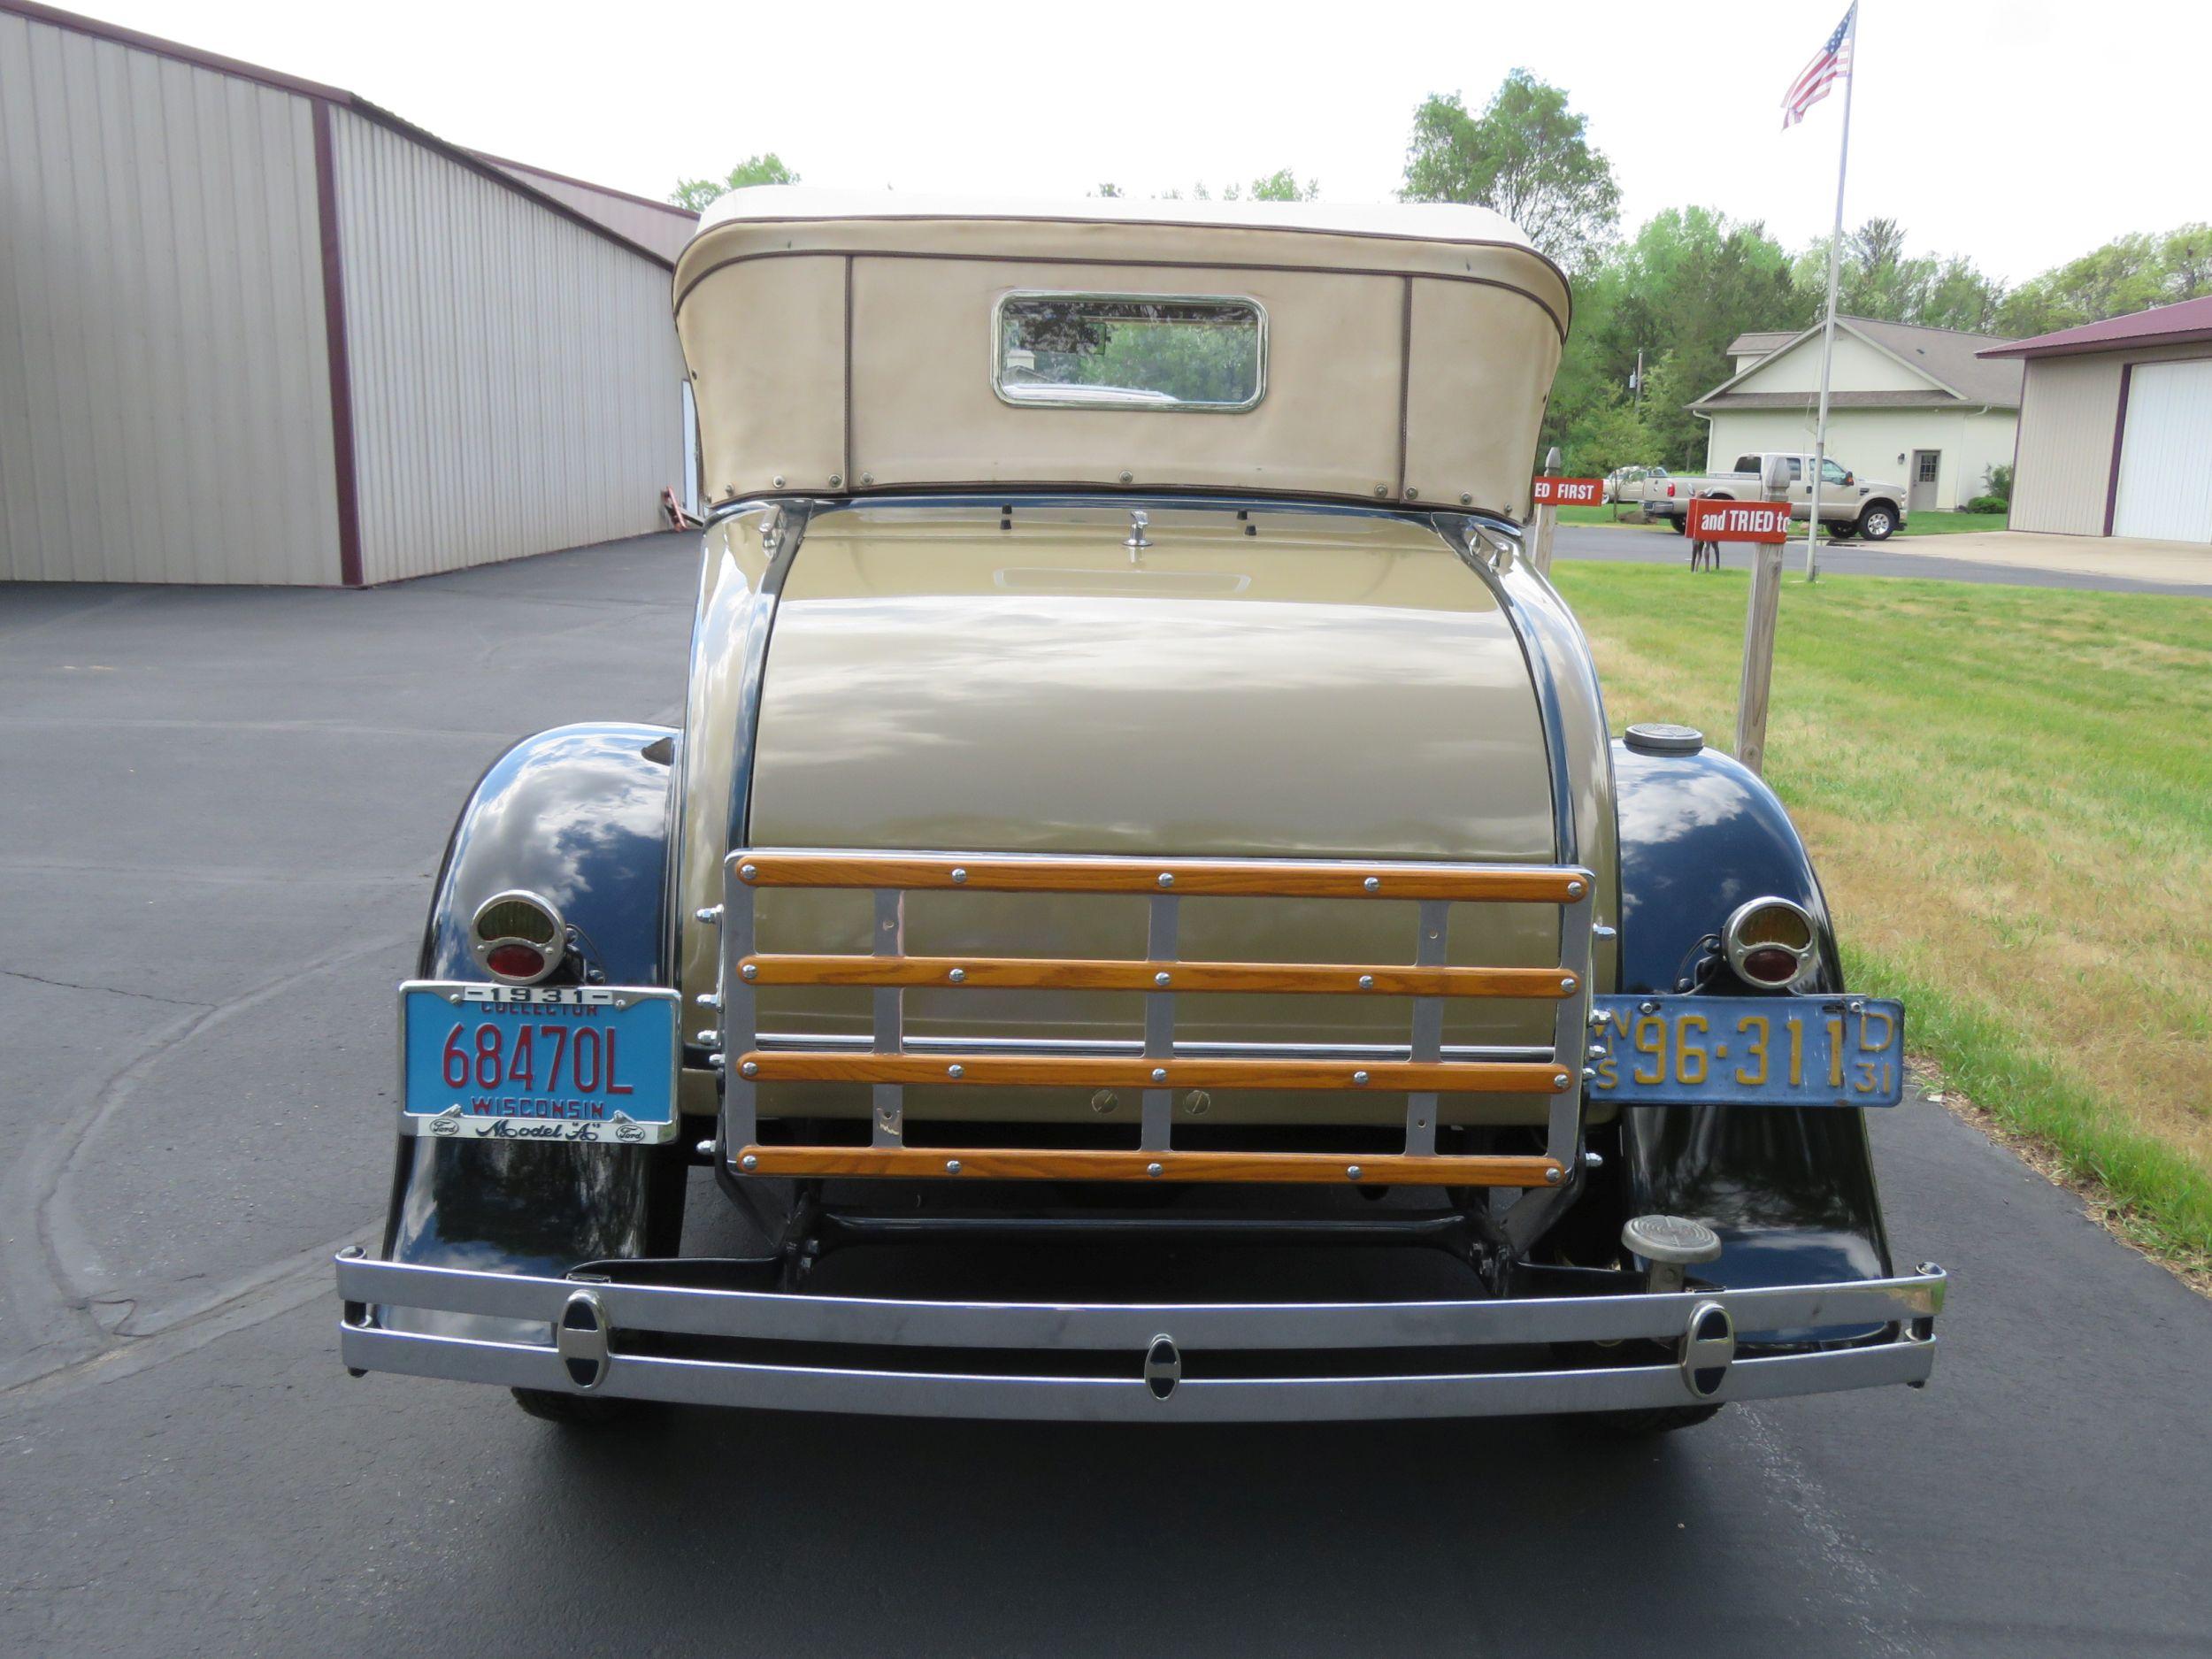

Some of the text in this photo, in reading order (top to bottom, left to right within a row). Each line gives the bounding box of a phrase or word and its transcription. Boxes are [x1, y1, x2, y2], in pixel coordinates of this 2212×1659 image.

[1557, 483, 1594, 500] FIRST
[1701, 510, 1726, 531] and
[1729, 510, 1774, 533] TRIED
[1859, 1013, 1894, 1051] D
[442, 1021, 634, 1094] 68470L
[1854, 1063, 1892, 1094] 31
[471, 1095, 605, 1119] WISCONSIN
[431, 1120, 458, 1134] Ford
[475, 1118, 563, 1138] Model
[618, 1125, 643, 1140] Ford
